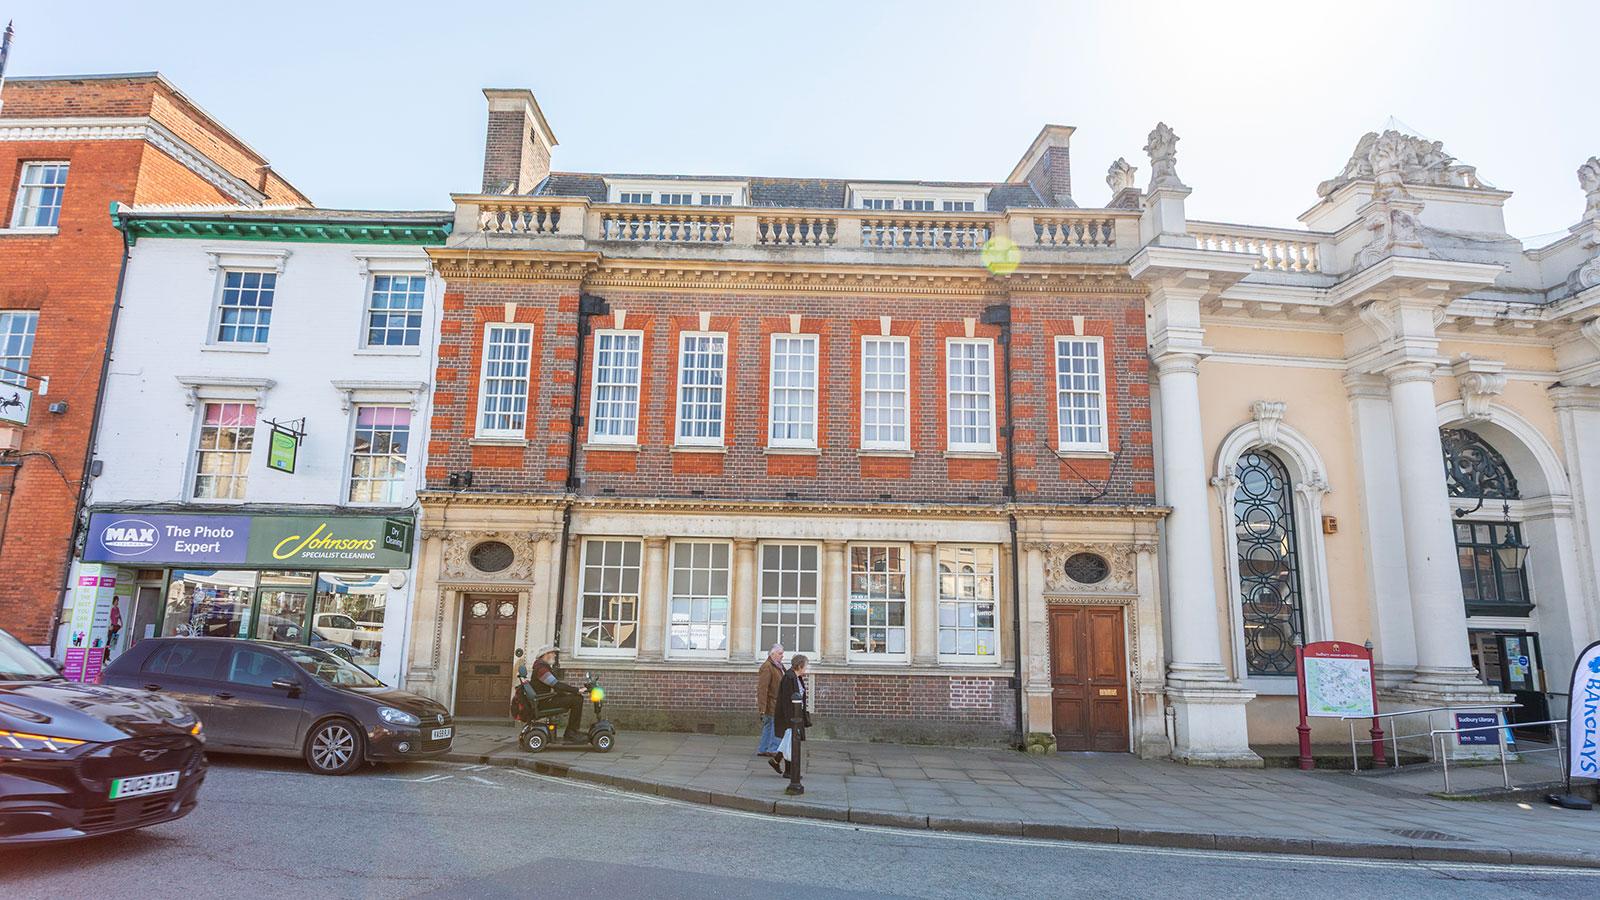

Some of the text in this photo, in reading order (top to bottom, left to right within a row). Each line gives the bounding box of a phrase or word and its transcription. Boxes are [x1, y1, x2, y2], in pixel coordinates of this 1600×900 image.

[105, 528, 155, 541] MAX
[165, 525, 234, 538] The Photo
[391, 527, 400, 538] Dry
[174, 540, 221, 555] Expert
[272, 523, 376, 560] Johnsons
[385, 537, 403, 549] Cleaning
[301, 551, 340, 559] SPECIALIST
[1580, 678, 1600, 773] BARCLAYS
